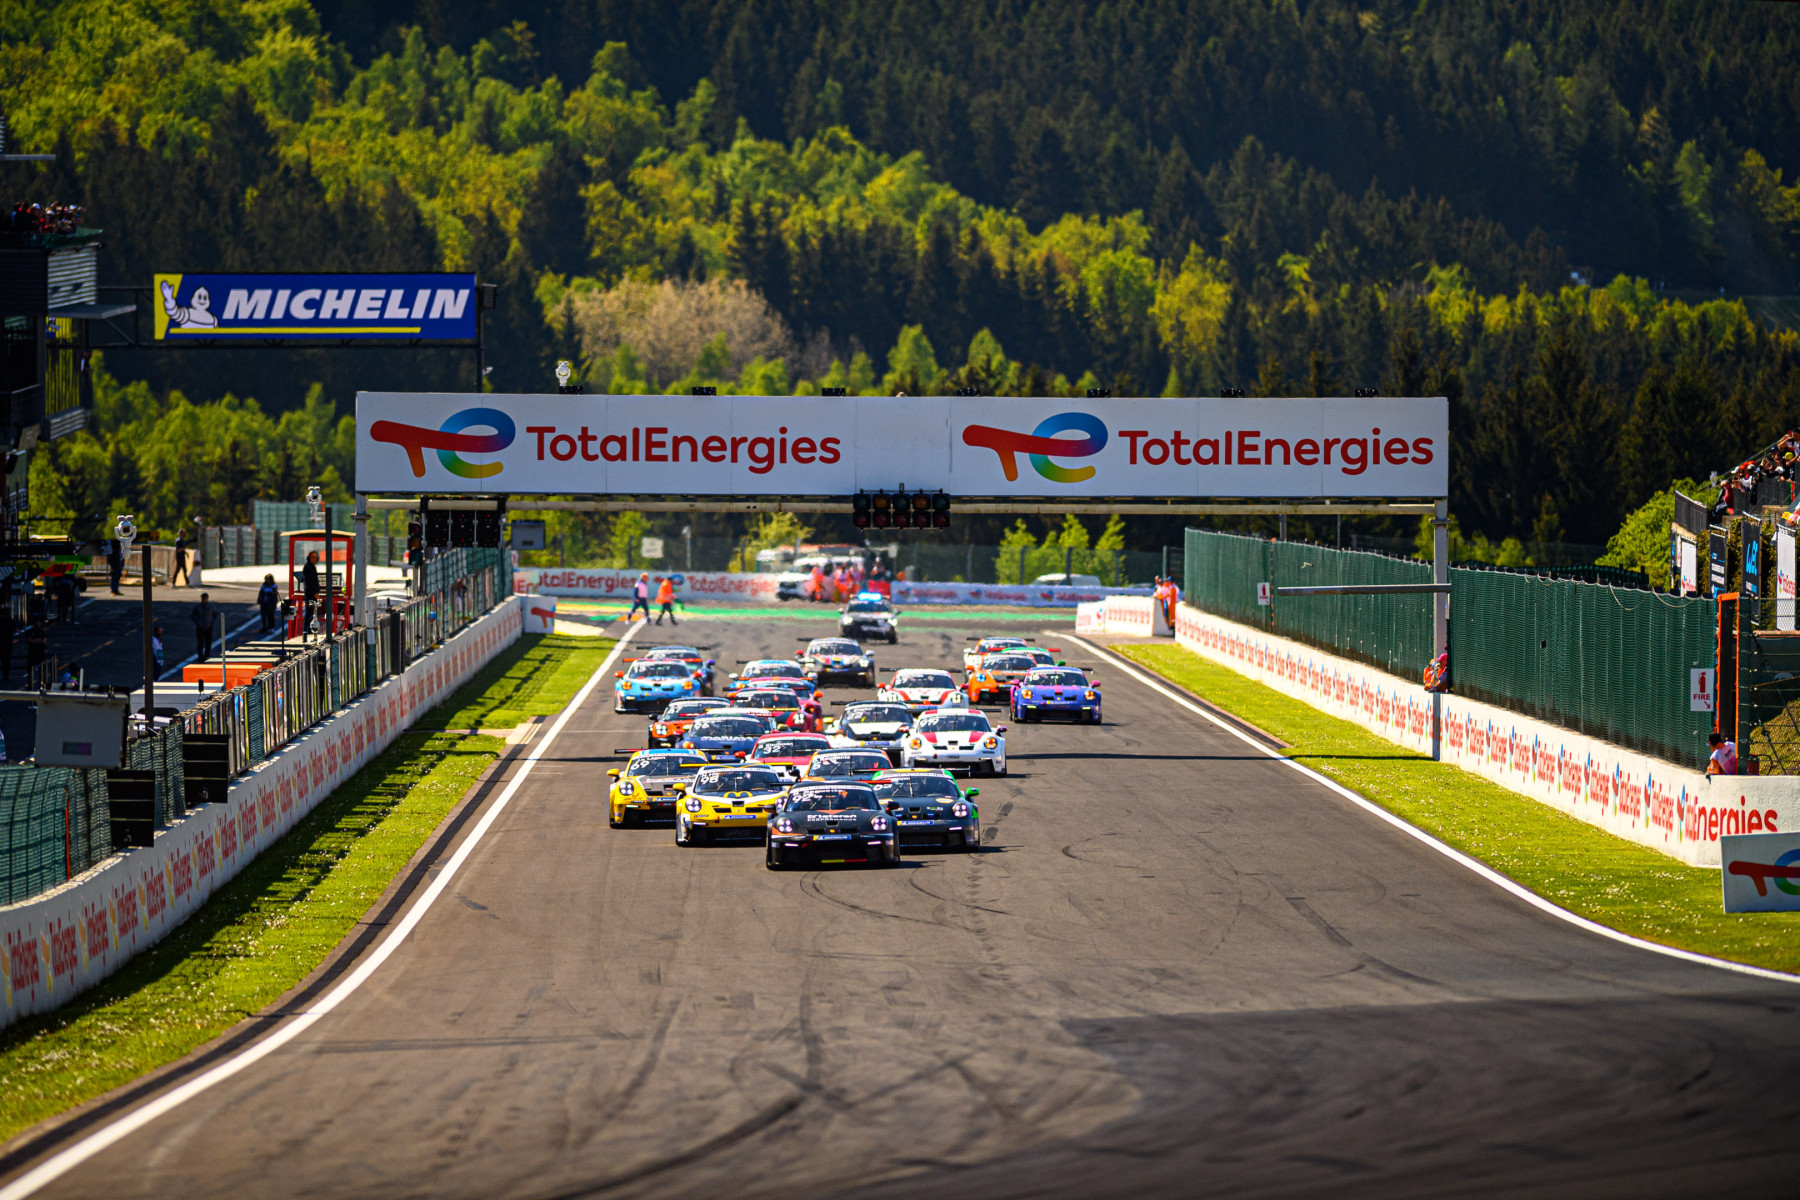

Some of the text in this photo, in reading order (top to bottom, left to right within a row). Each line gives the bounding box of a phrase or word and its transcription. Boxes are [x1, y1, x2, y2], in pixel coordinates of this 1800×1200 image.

[222, 288, 470, 320] MICHELIN
[526, 426, 841, 475] TotalEnergies
[1119, 427, 1434, 476] TotalEnergies
[538, 571, 638, 593] otalEnergies
[1693, 693, 1711, 701] FIRE
[763, 745, 782, 755] 32
[630, 760, 650, 771] 69
[700, 776, 719, 785] 98
[792, 793, 812, 804] 92
